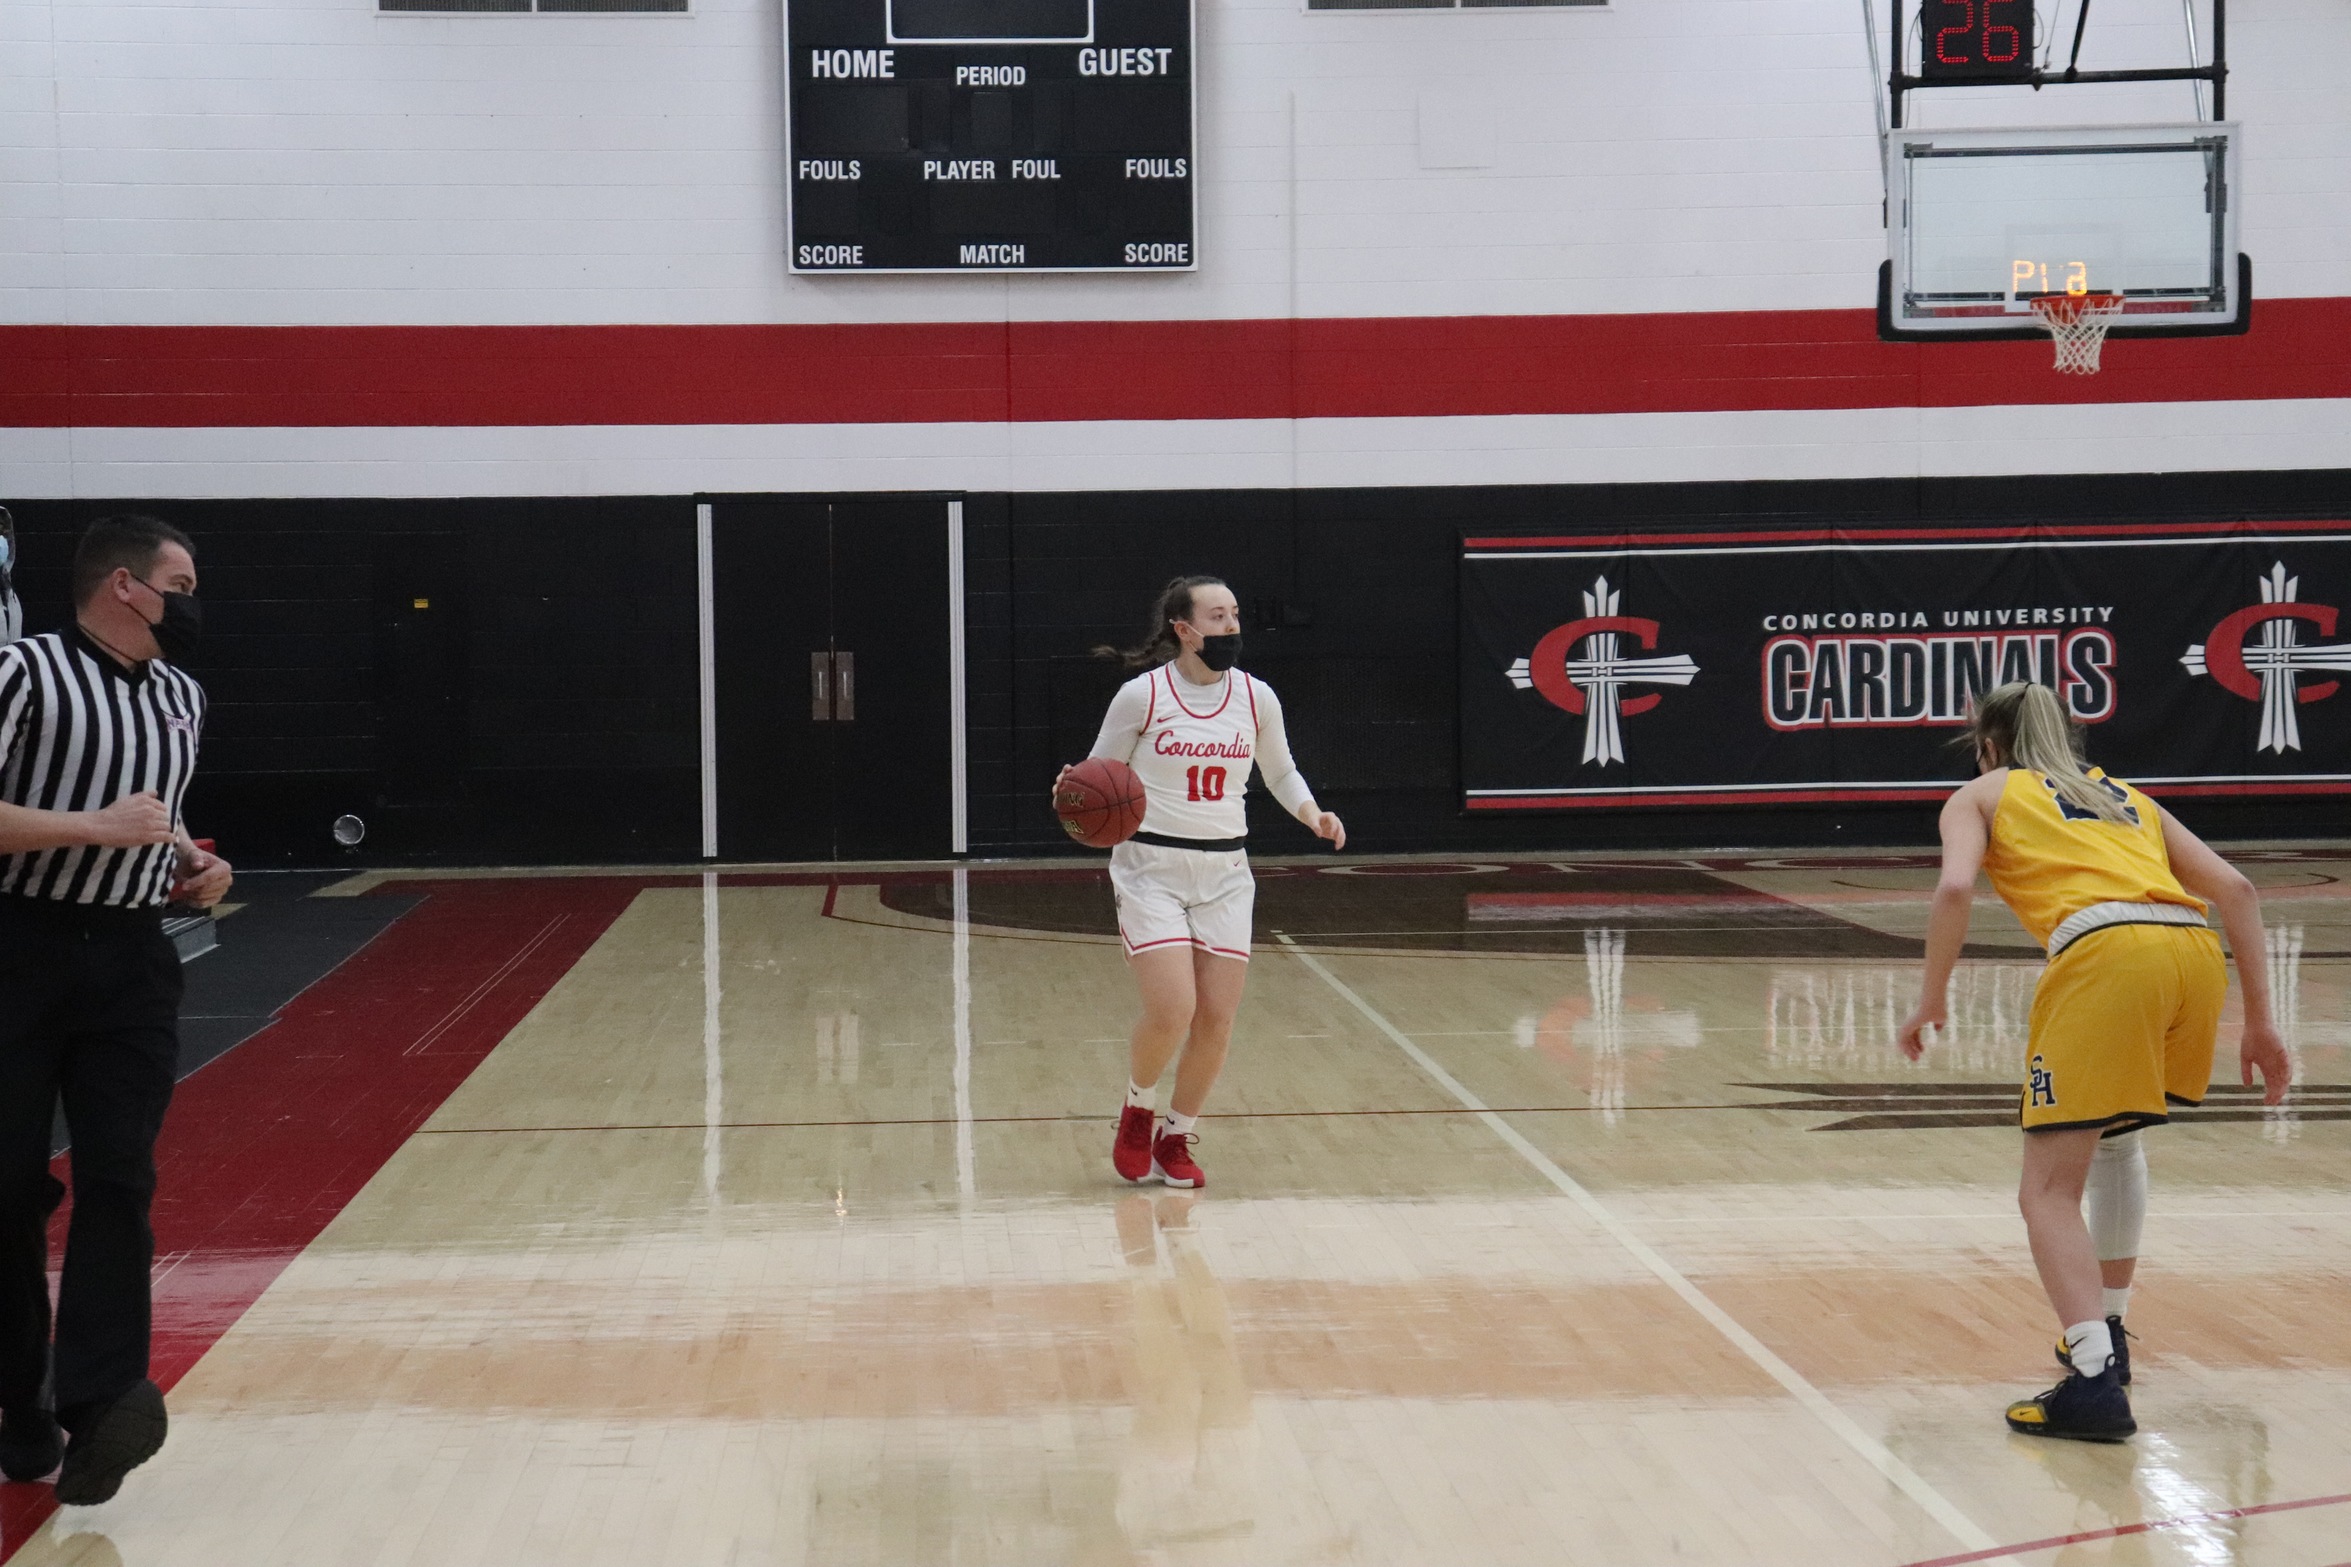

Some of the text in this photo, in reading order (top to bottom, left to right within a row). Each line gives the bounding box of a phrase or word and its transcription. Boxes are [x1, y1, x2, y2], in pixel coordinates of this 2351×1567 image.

[1936, 0, 2019, 63] 26
[812, 49, 895, 79] HOME
[1078, 47, 1173, 76] GUEST
[956, 65, 1026, 86] PERIOD
[799, 160, 861, 180] FOULS
[923, 159, 1061, 180] PLAYER FOUL
[1125, 158, 1187, 179] FOULS
[799, 245, 863, 265] SCORE
[960, 244, 1025, 264] MATCH
[1124, 243, 1189, 263] SCORE
[1763, 606, 2114, 631] CONCORDIA UNIVERSITY
[1155, 730, 1251, 759] Concordia
[1187, 765, 1227, 801] 10
